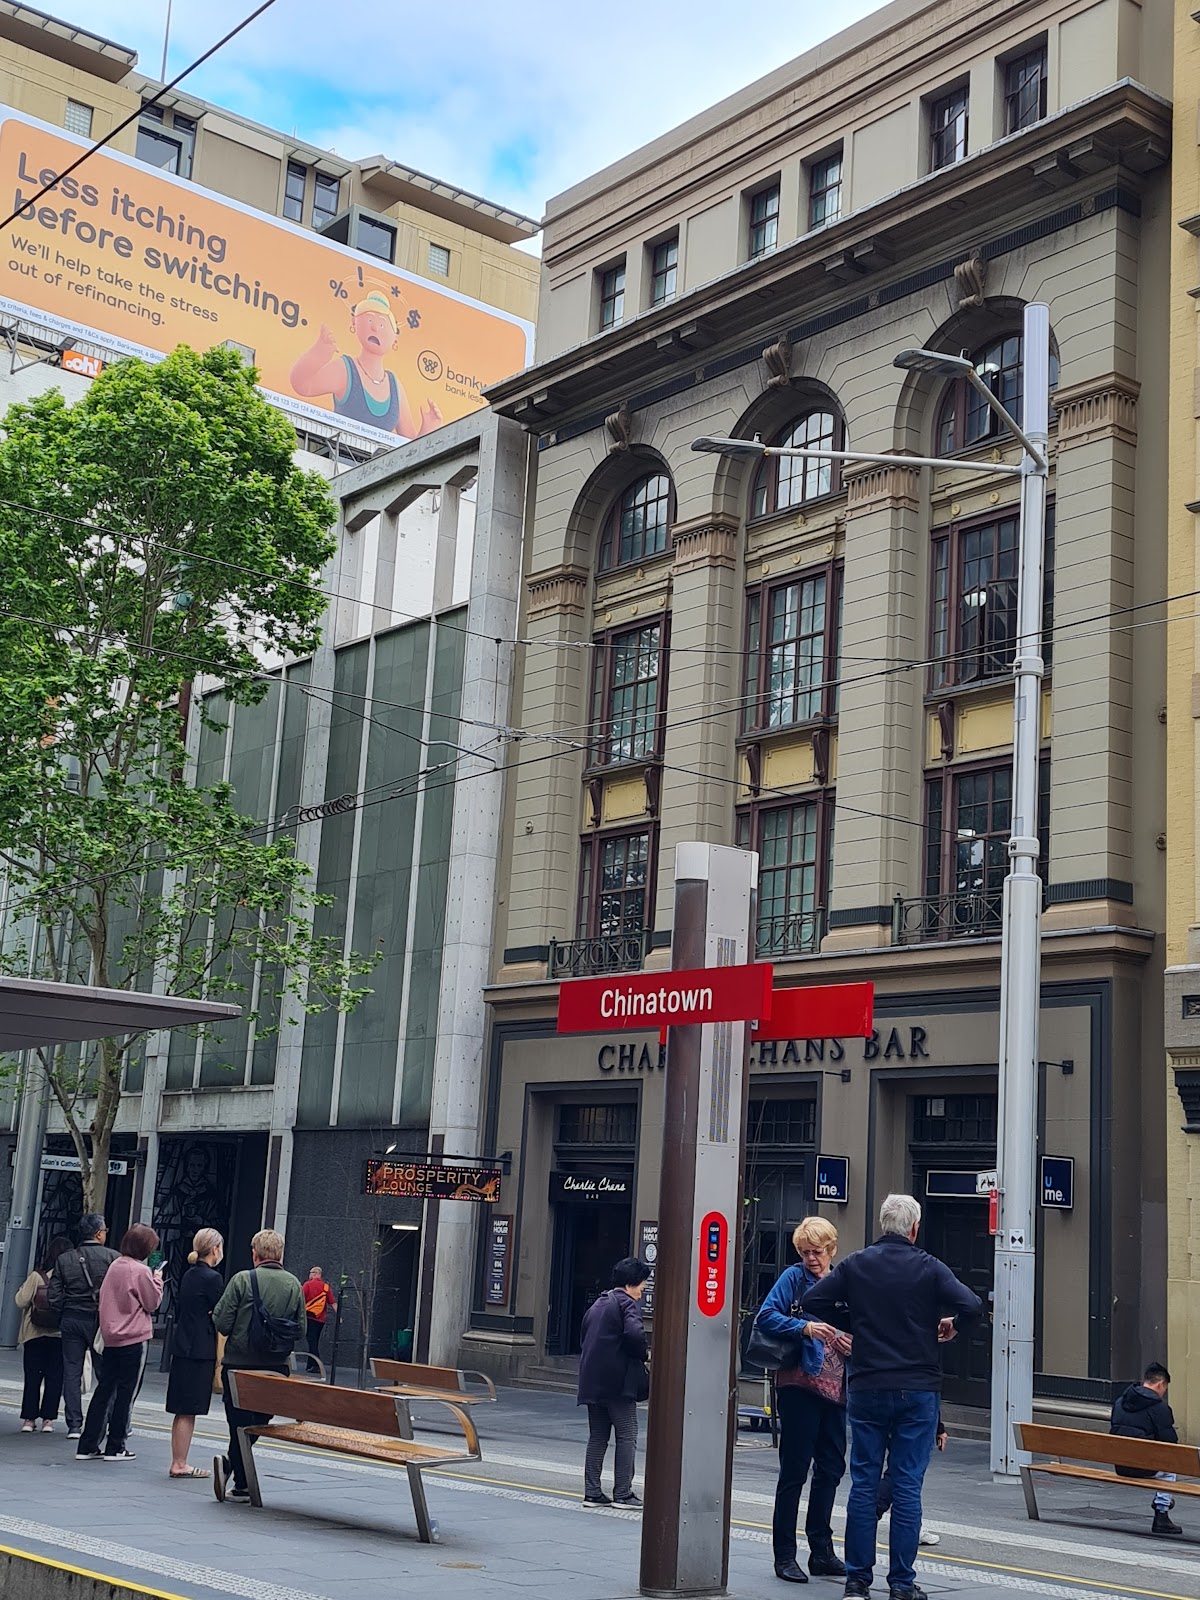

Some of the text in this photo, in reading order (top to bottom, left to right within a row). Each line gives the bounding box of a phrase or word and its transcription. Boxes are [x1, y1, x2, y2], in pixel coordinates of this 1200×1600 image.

[18, 152, 227, 263] Less itching
[14, 188, 308, 328] before switching.
[11, 233, 218, 322] We'll help take the stress
[8, 260, 165, 326] out of refinancing.
[445, 382, 466, 398] bank
[600, 986, 713, 1018] Chinatown
[750, 1038, 845, 1065] HANS
[862, 1026, 930, 1060] BAR
[382, 1167, 481, 1186] PROSPERITY
[563, 1176, 626, 1192] Charlie Chans
[382, 1180, 433, 1193] LOUNGE
[493, 1226, 508, 1234] HOUR
[643, 1226, 658, 1234] HAPP
[707, 1266, 718, 1274] Tap
